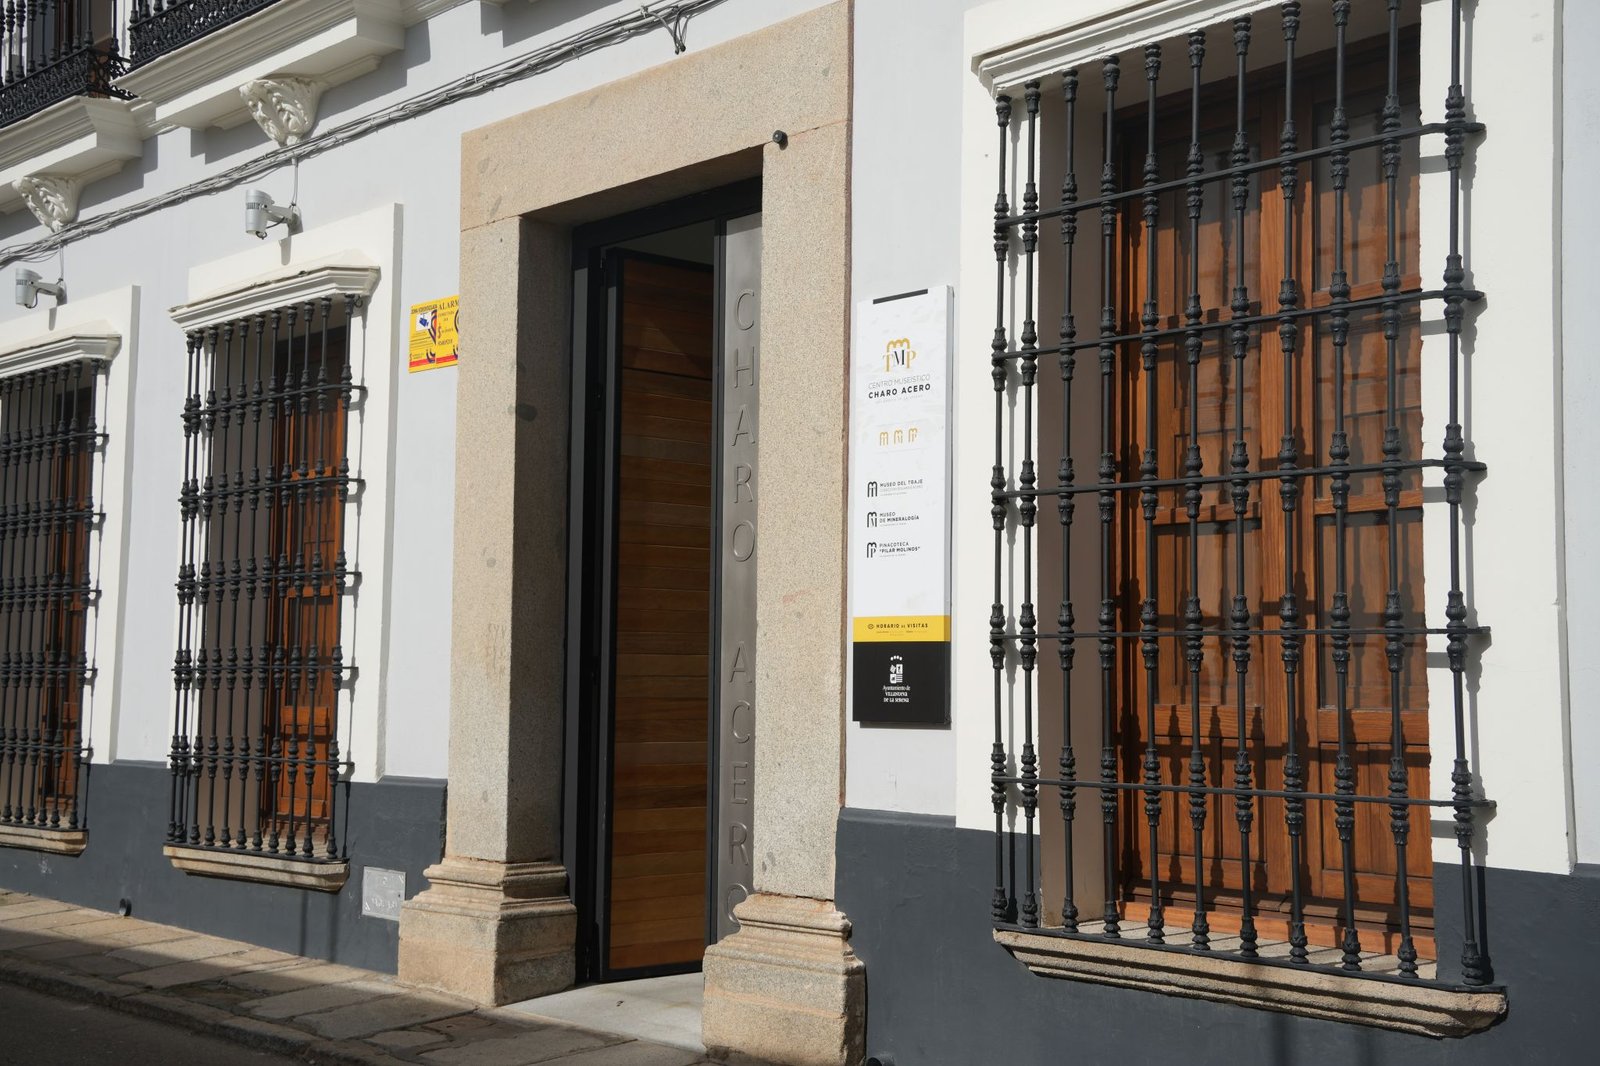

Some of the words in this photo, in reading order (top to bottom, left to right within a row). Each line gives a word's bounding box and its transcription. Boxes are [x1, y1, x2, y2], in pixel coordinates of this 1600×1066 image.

[868, 380, 893, 390] CENTRO
[868, 388, 898, 399] CHARO
[901, 383, 931, 394] ACERO
[732, 288, 756, 563] CHARO
